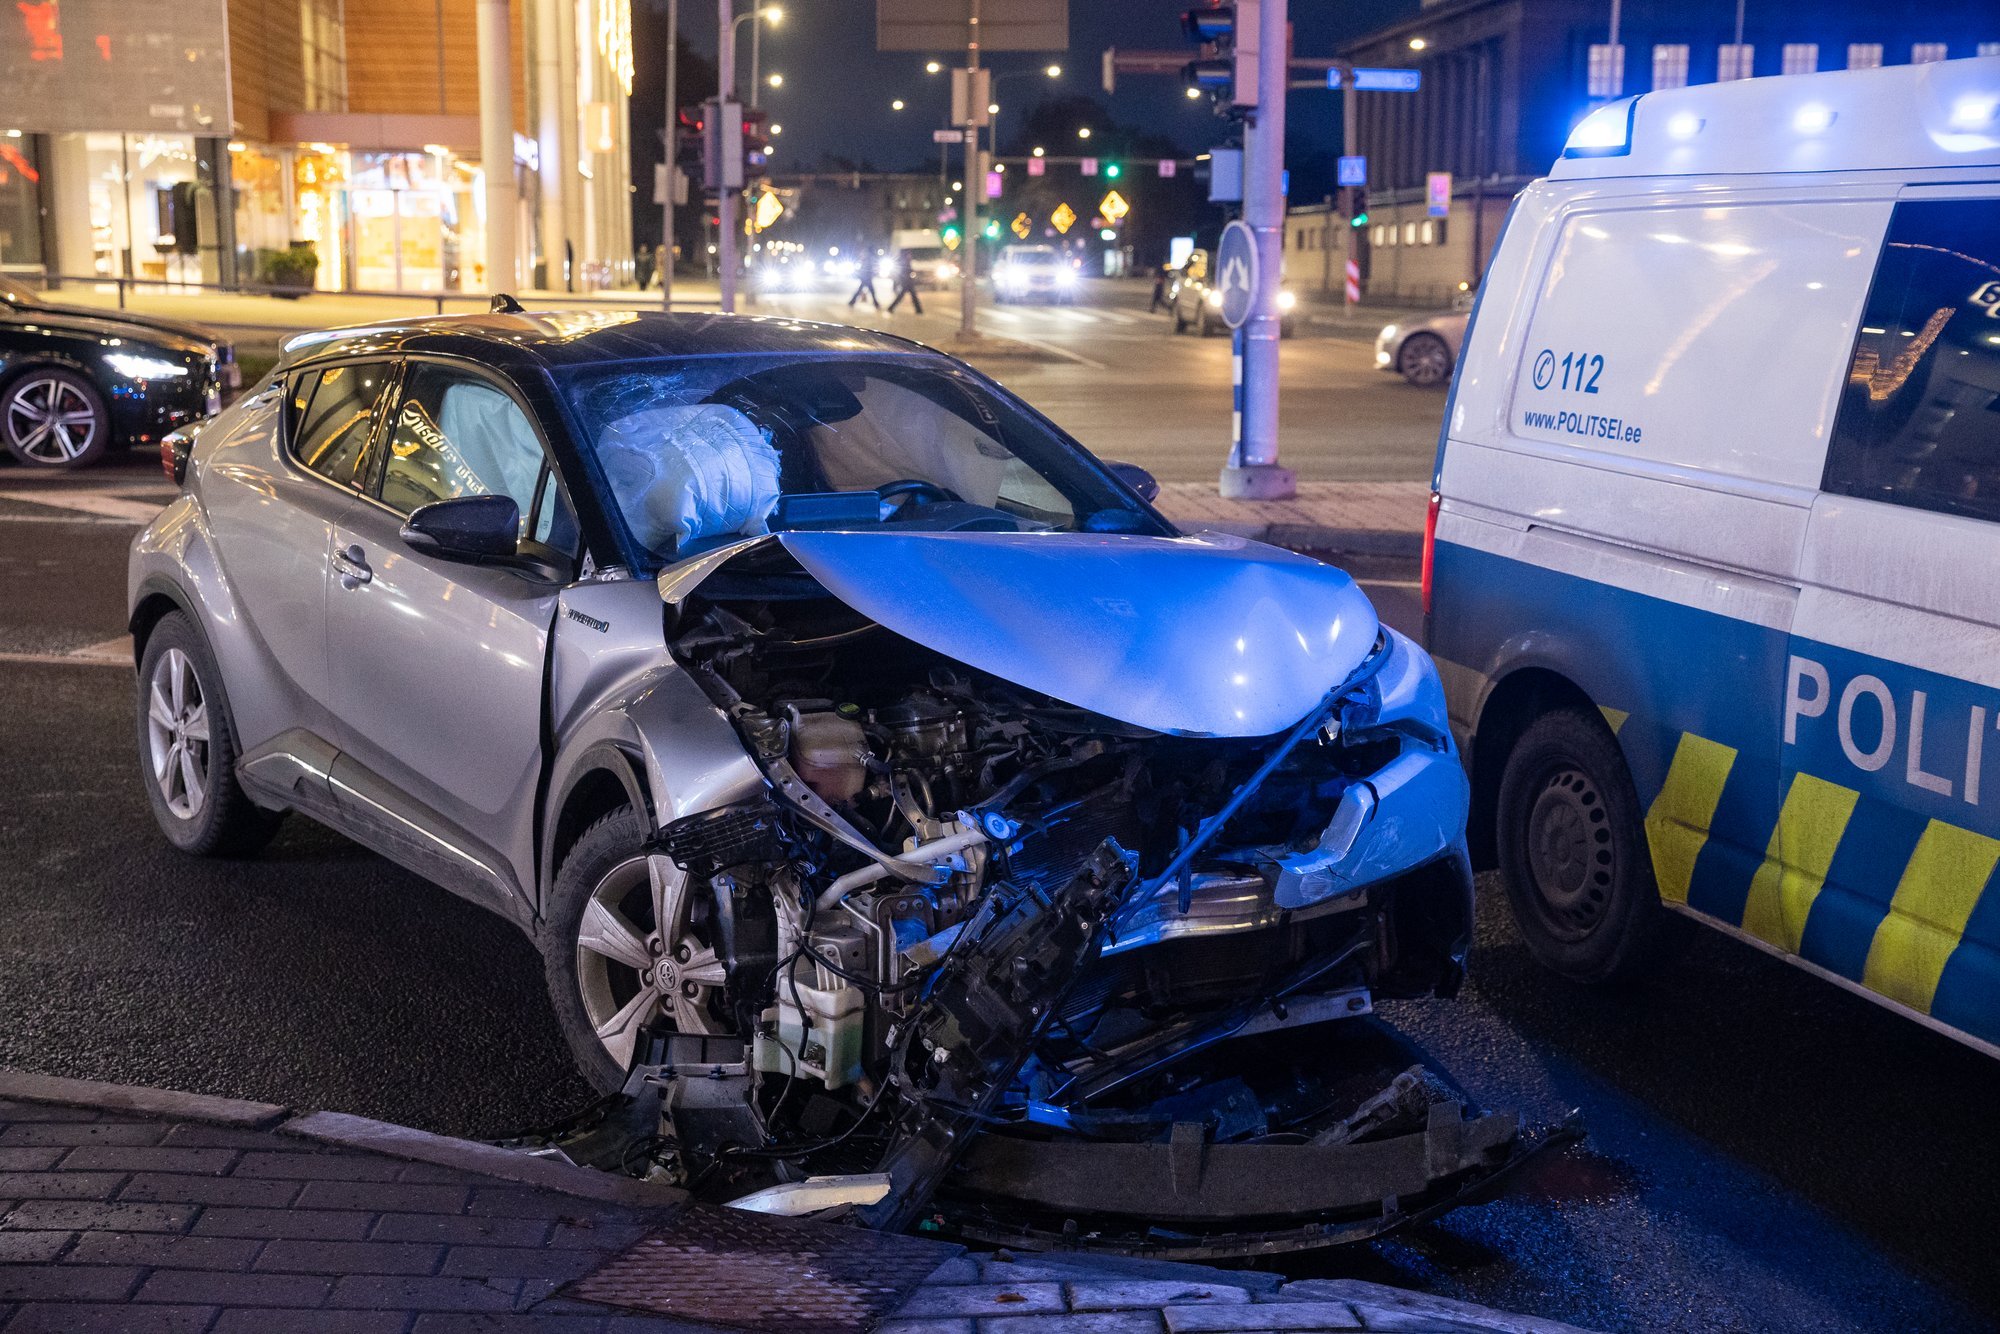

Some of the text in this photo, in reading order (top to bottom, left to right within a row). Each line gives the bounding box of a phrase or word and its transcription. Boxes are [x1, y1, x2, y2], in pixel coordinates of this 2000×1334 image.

[1561, 351, 1605, 394] 112
[1524, 410, 1642, 443] www.POLITSEI.ee
[1784, 654, 2000, 806] POLI
